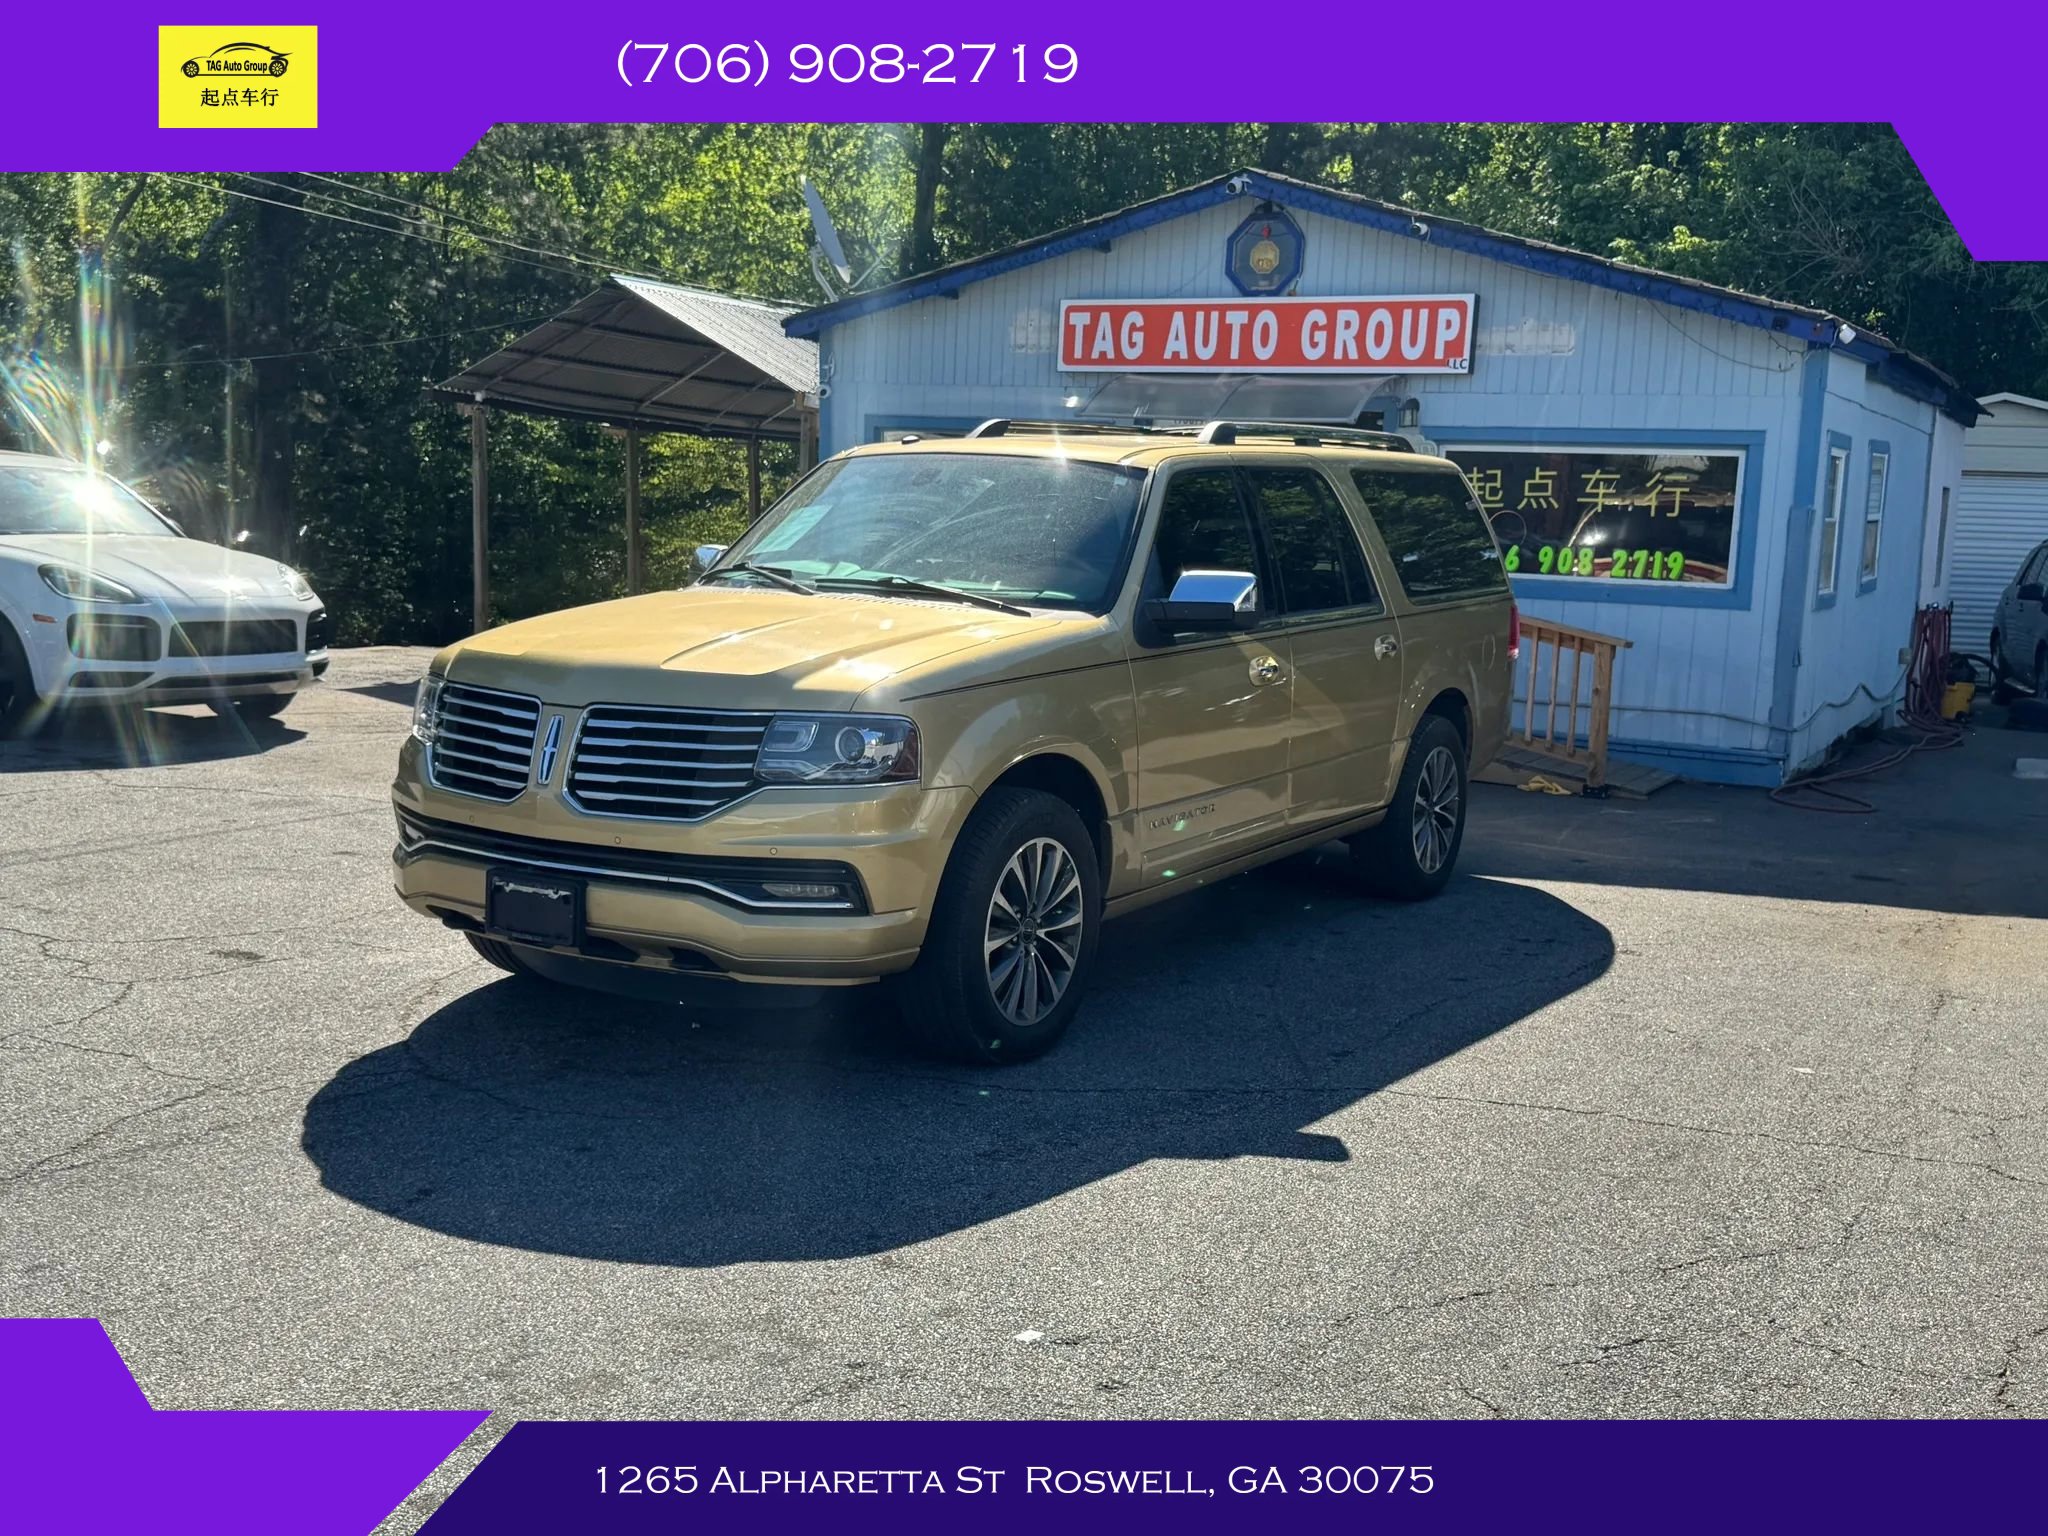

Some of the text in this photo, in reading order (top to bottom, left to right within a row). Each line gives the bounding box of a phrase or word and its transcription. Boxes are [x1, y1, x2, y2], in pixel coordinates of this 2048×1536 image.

[1068, 307, 1463, 361] TAG AUTO GROUP
[1446, 358, 1469, 370] LLC
[1466, 466, 1690, 518] 起点车行
[1538, 546, 1595, 577] 908
[1611, 549, 1686, 580] 2719
